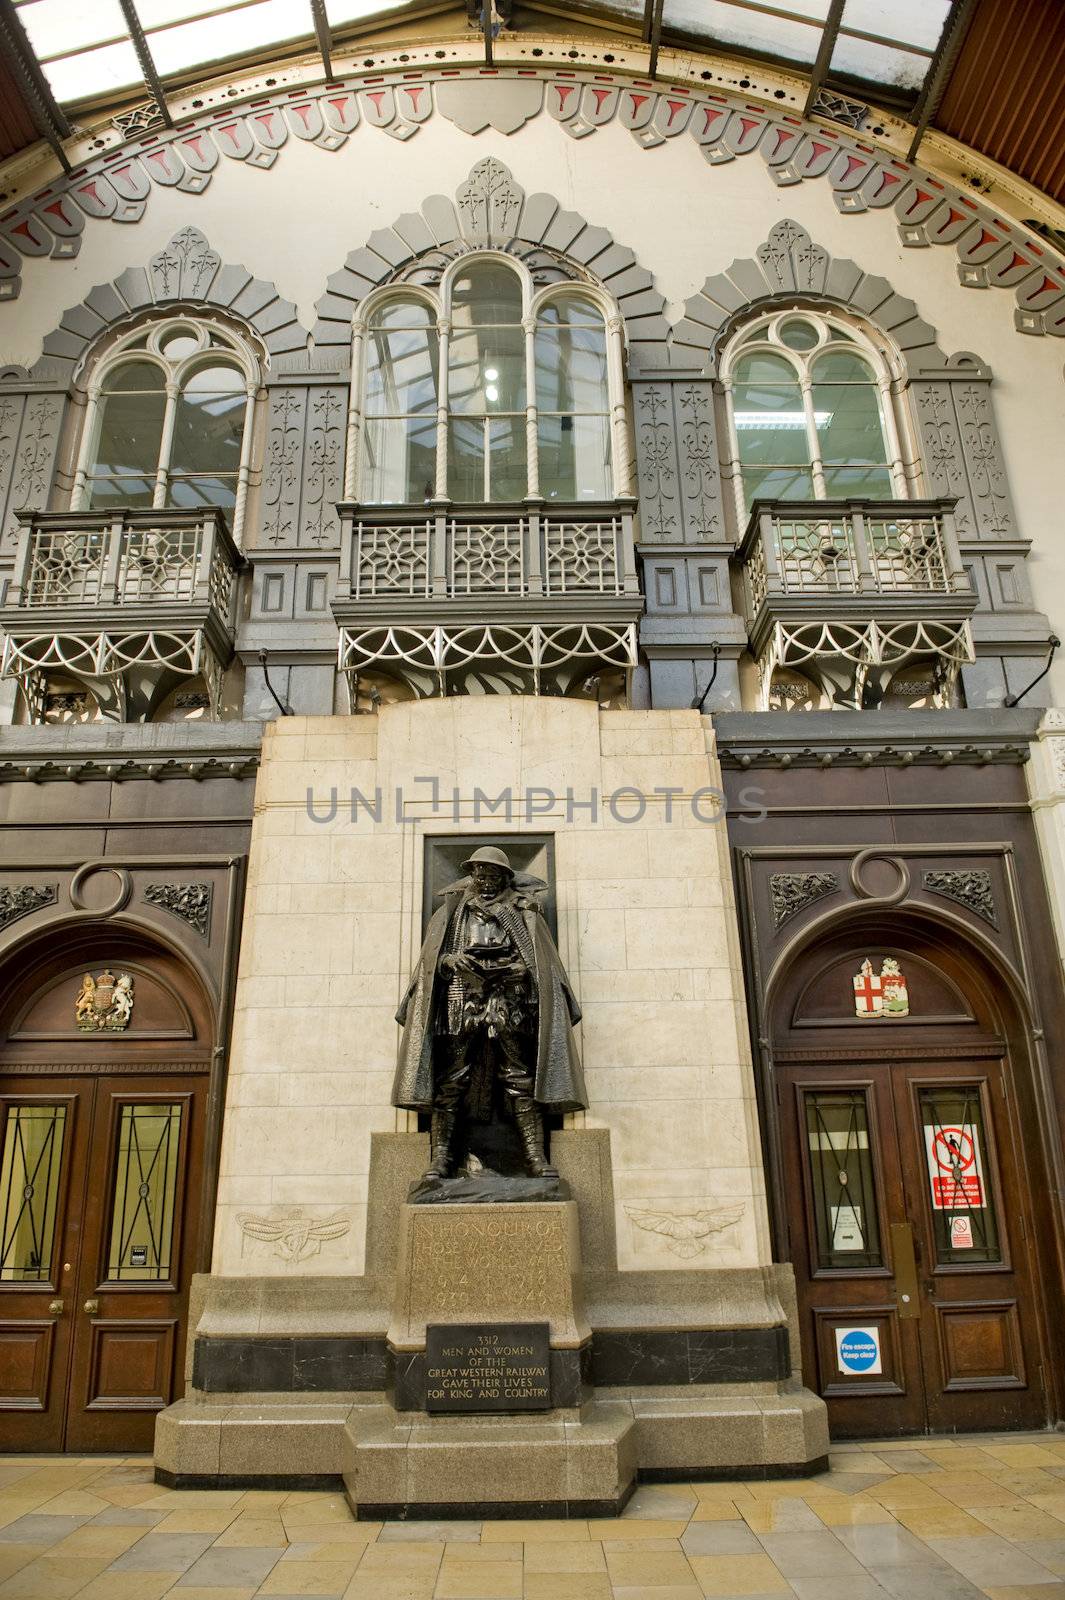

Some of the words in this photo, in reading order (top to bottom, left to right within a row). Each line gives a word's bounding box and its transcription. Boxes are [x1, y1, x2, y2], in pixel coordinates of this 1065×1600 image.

[439, 1222, 532, 1237] HONOUR
[536, 1220, 562, 1236] OF
[477, 1335, 500, 1345] 3312
[442, 1347, 463, 1357] MEN
[468, 1347, 490, 1356] AND
[494, 1346, 534, 1356] WOMEN
[469, 1357, 482, 1367] OF
[486, 1357, 507, 1367] THE
[428, 1368, 458, 1378] GREAT
[459, 1367, 504, 1378] WESTERN
[506, 1367, 548, 1377] RAILWAY
[442, 1378, 469, 1388] GAVE
[472, 1378, 501, 1388] THEIR
[504, 1377, 533, 1387] LIVES
[427, 1389, 446, 1399] FOR
[450, 1389, 473, 1399] KING
[478, 1389, 500, 1398] AND
[504, 1388, 549, 1398] COUNTRY
